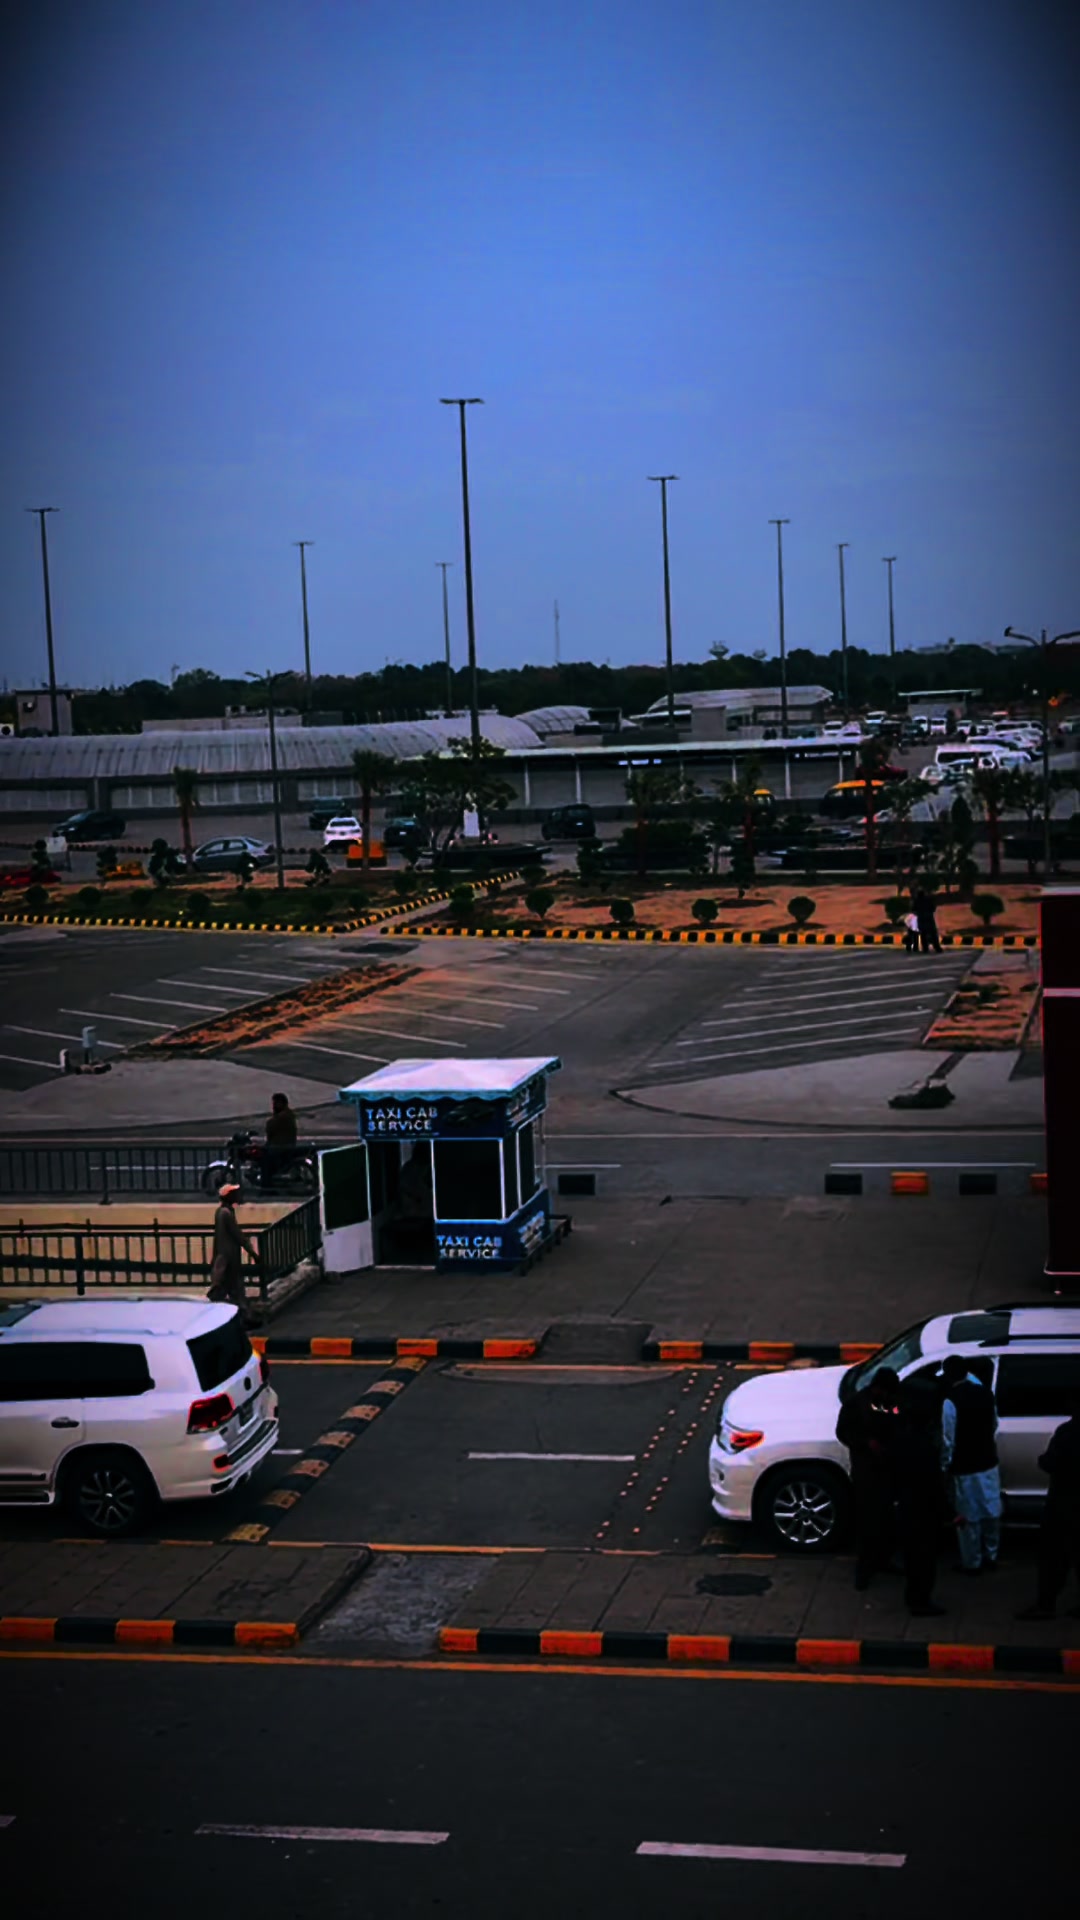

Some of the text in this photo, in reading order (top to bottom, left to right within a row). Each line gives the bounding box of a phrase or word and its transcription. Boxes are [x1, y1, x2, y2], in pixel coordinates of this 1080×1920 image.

[365, 1106, 439, 1120] TAXI CAB
[367, 1119, 433, 1132] SERVICE
[436, 1234, 503, 1248] TAXI CAB
[439, 1248, 501, 1260] SERVICE
